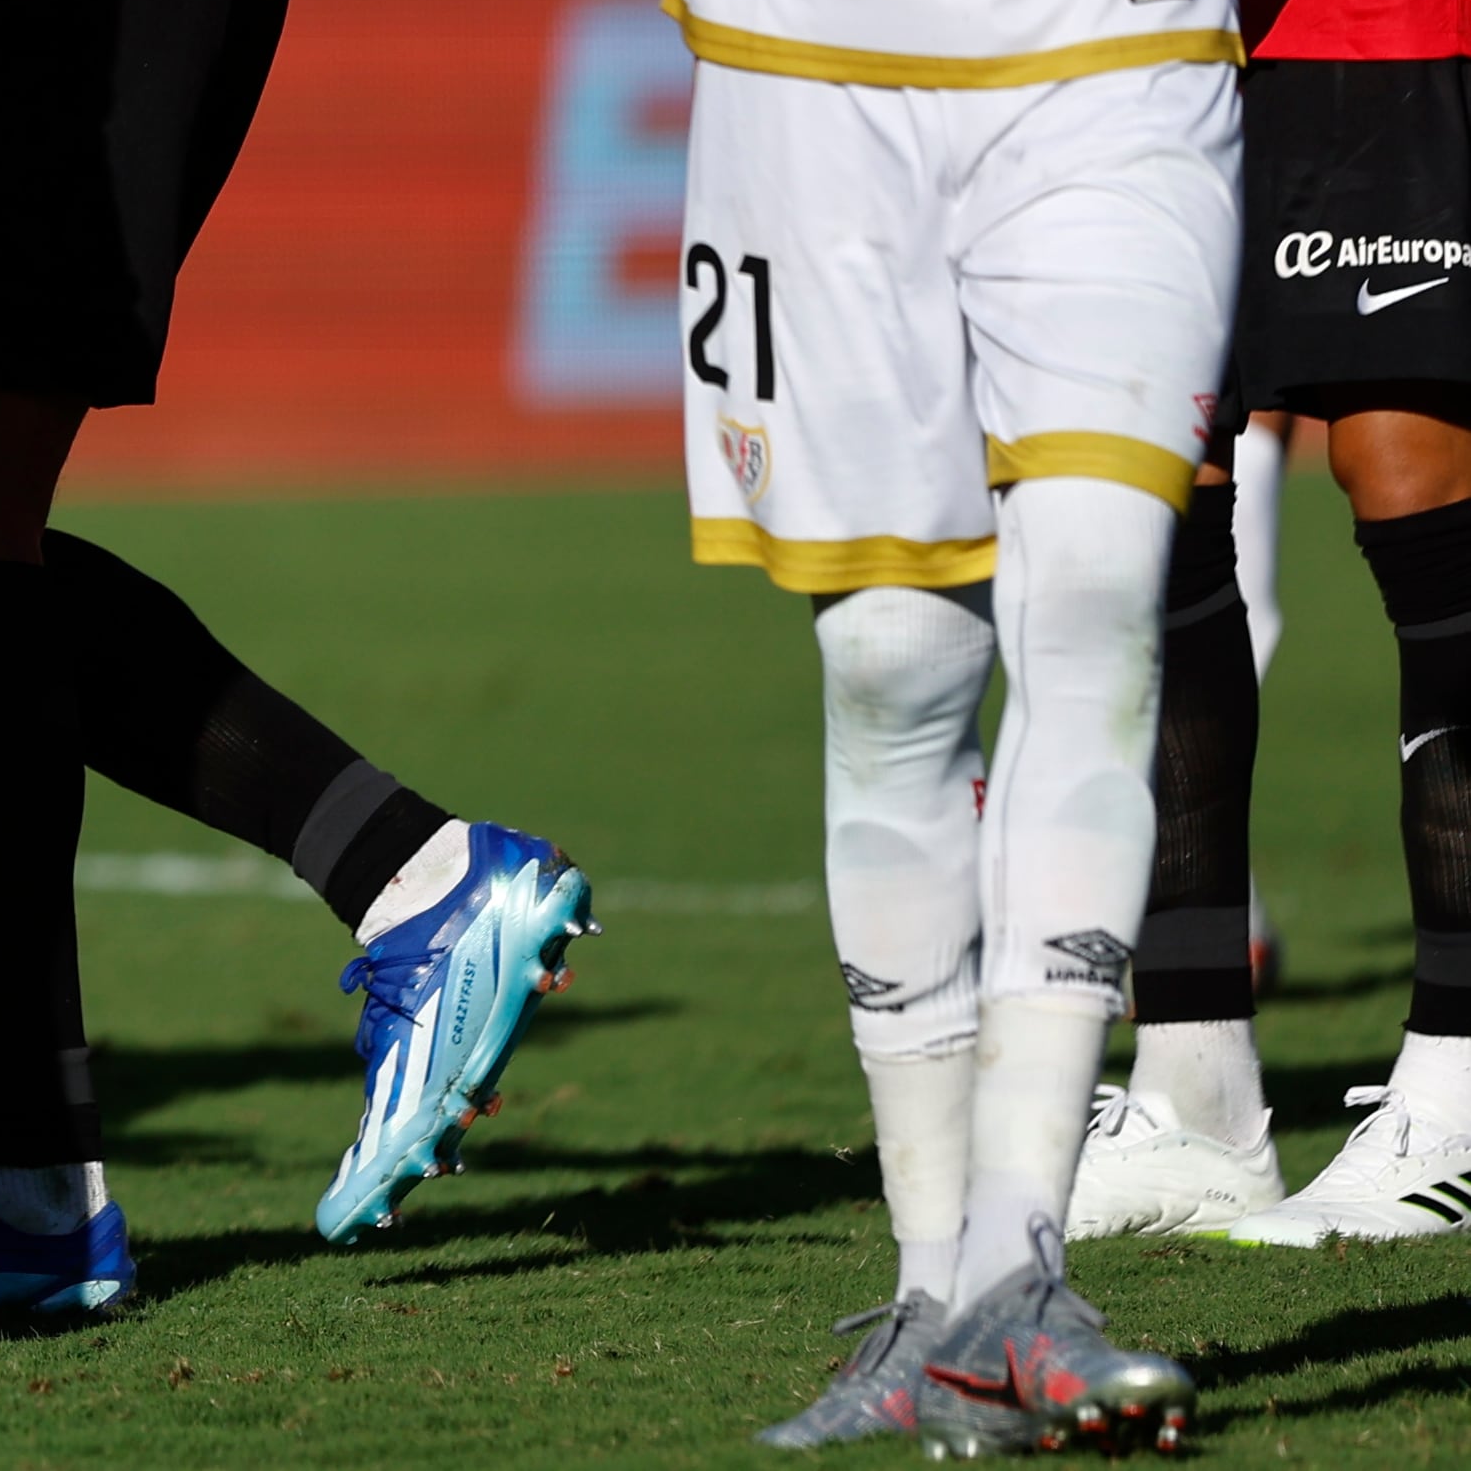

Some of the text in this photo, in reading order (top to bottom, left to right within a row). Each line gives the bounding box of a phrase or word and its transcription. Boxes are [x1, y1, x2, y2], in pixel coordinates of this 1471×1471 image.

[686, 242, 776, 403] 21
[451, 958, 478, 1045] CRAZYFAST
[1205, 1187, 1237, 1203] COPA
